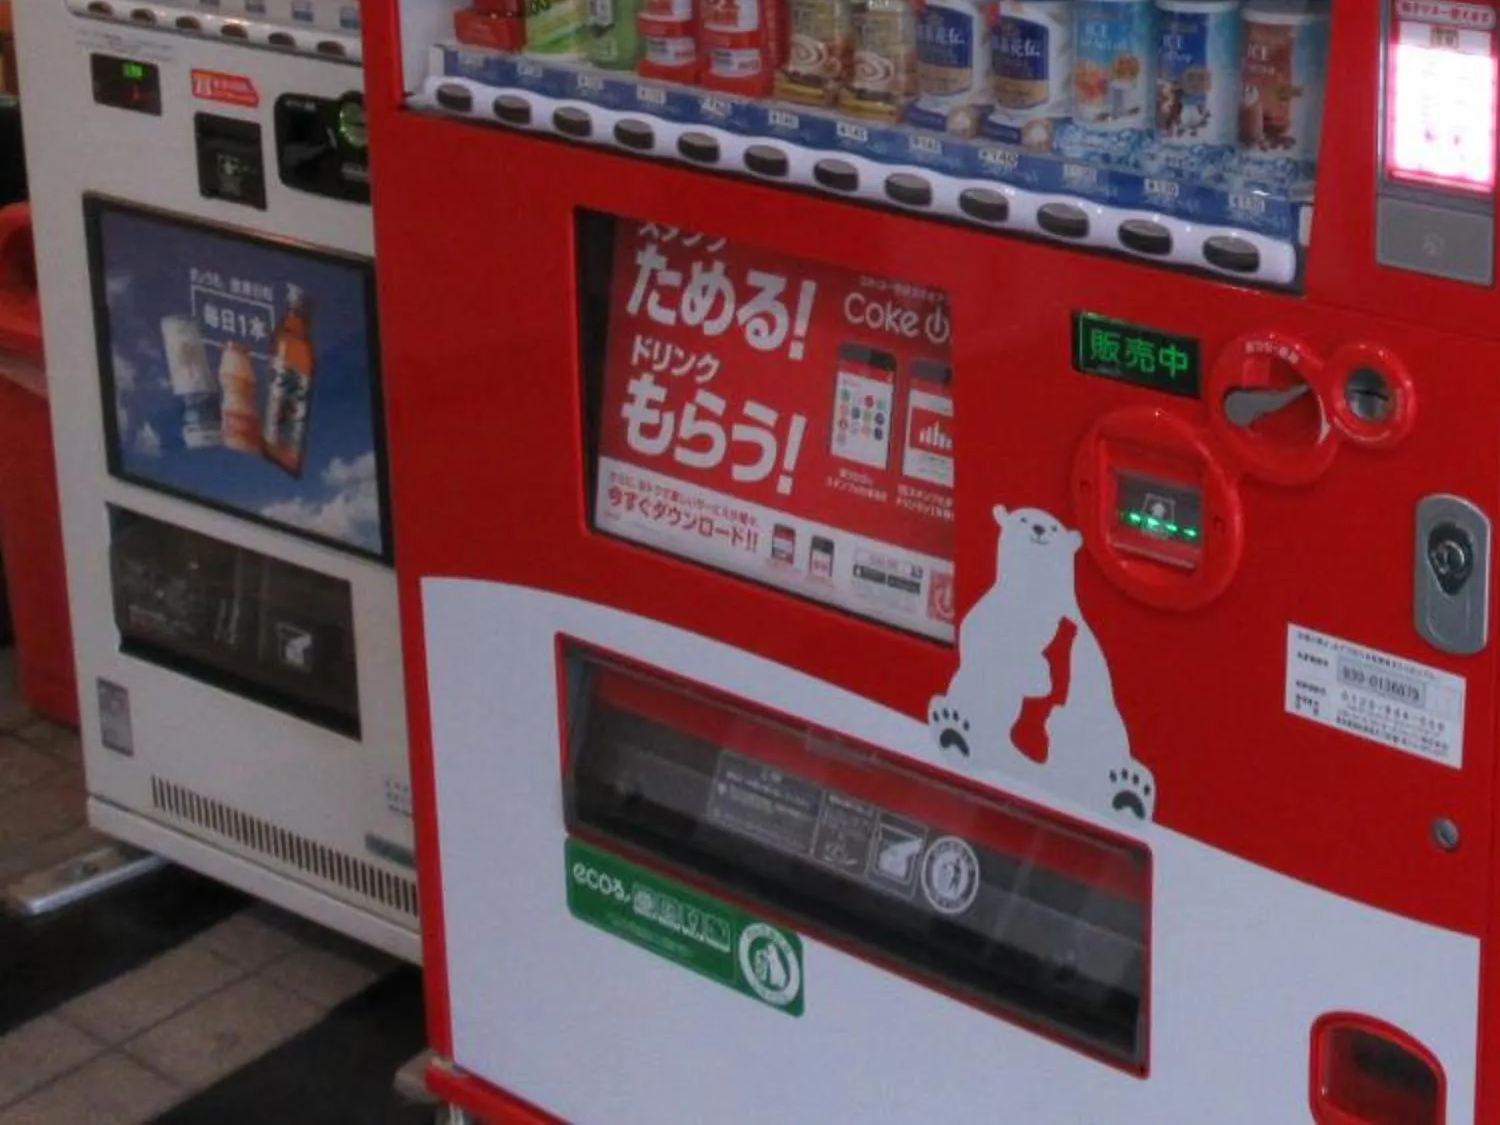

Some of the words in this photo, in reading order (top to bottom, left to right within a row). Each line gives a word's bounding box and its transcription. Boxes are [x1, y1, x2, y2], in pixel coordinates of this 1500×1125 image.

[625, 241, 817, 361] ためる!
[842, 290, 921, 339] Coke
[923, 306, 951, 345] O
[629, 332, 722, 384] ドリンク
[1089, 327, 1190, 380] 販売中
[619, 371, 808, 496] もらう!
